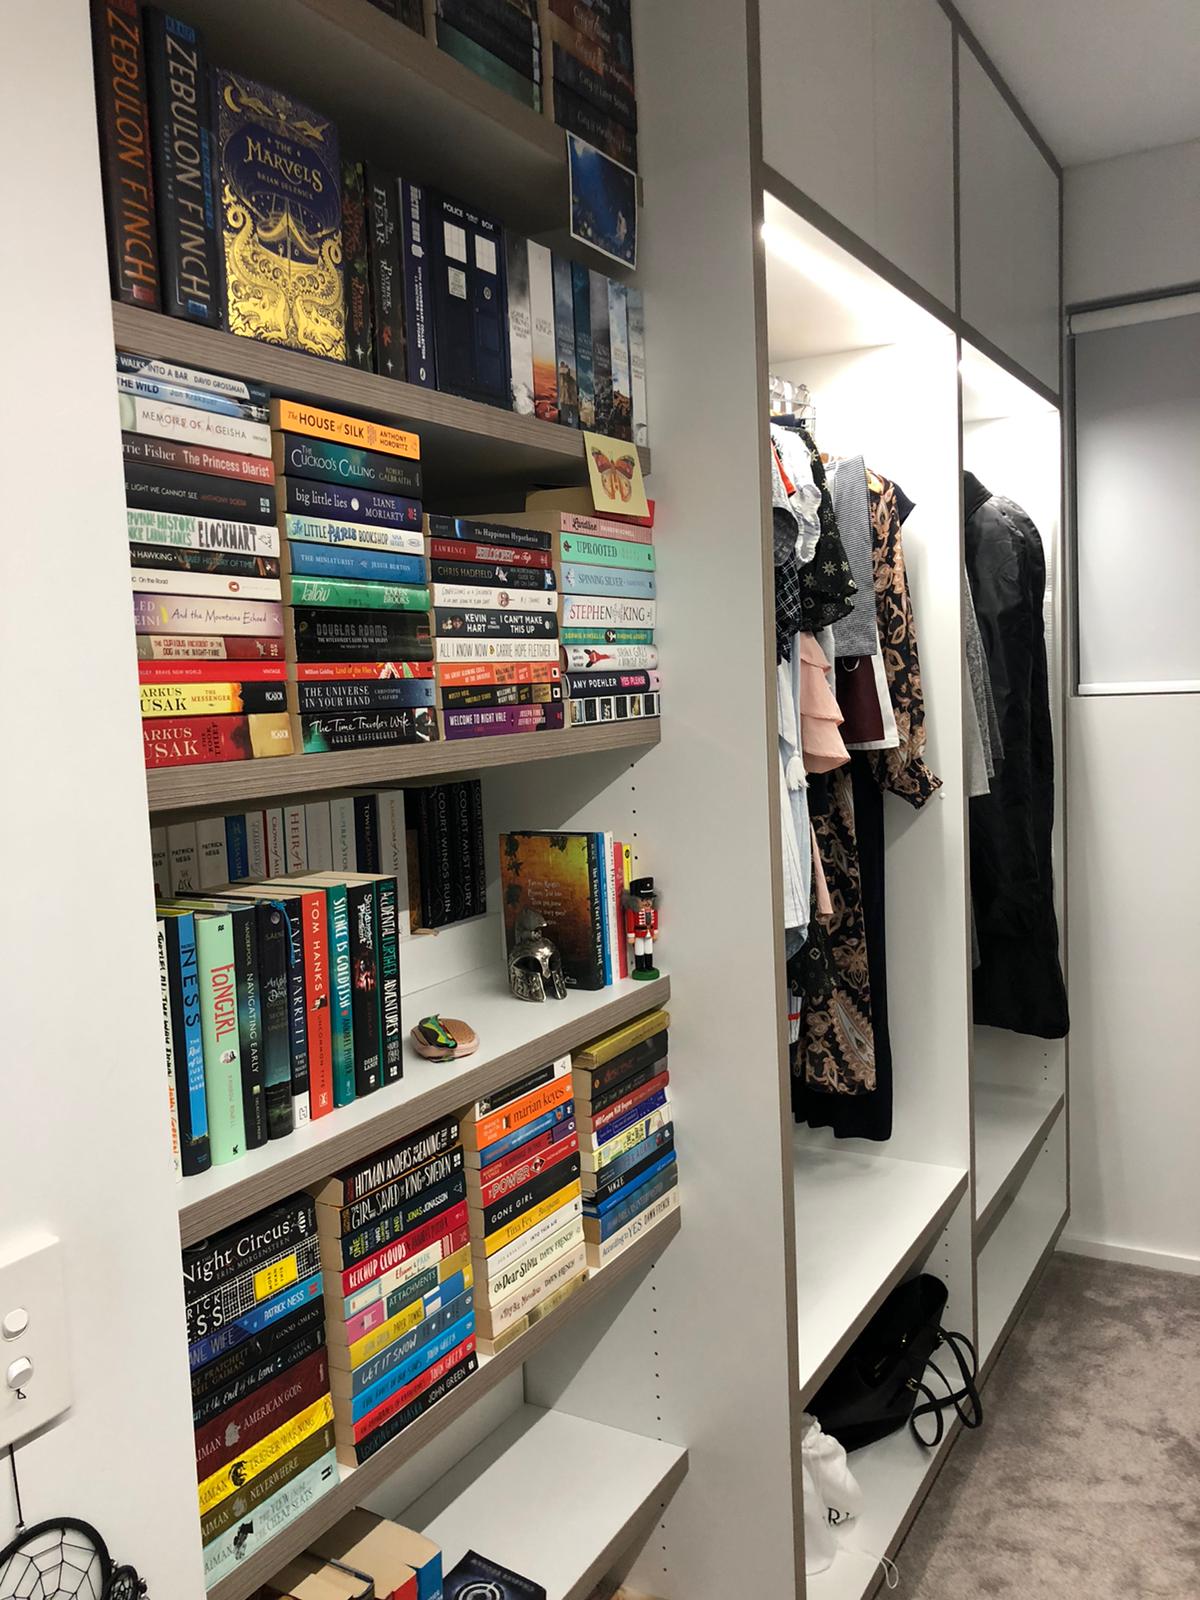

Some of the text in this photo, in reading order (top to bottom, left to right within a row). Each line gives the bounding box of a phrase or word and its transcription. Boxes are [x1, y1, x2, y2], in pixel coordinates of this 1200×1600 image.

[167, 35, 201, 190] ZEBULON
[108, 9, 156, 284] ZEBULON FINCH
[443, 203, 464, 218] POLICE
[482, 220, 495, 231] BOX
[179, 199, 210, 299] FINCH
[136, 380, 160, 394] WILD
[148, 364, 166, 376] INTO
[167, 370, 174, 378] A
[175, 371, 189, 380] BAR
[194, 376, 212, 386] DAVID
[213, 380, 245, 394] GROSSMAN
[143, 412, 187, 428] MEMOIRS
[206, 422, 214, 432] A
[215, 426, 247, 440] GEISHA
[299, 414, 336, 433] HOUSE
[345, 424, 365, 439] SILK
[380, 430, 407, 443] ANTHONY
[302, 445, 313, 456] THE
[380, 439, 409, 451] HOROWITZ
[145, 445, 271, 478] Fisher The Princess Diarist
[292, 450, 376, 480] CUCKOO'S CALLING
[131, 484, 198, 501] LIGHT WE CANNOT SEE
[296, 488, 348, 510] big little lies
[373, 497, 397, 510] LIANE
[365, 508, 405, 522] MORIARTY
[304, 524, 327, 540] LITTLE
[328, 525, 358, 543] PARIS
[359, 531, 389, 546] BOOKSHOP
[138, 552, 173, 563] HAWKING
[301, 554, 314, 562] THE
[576, 542, 618, 558] UPROOTED
[438, 566, 459, 577] CHRIS
[465, 614, 488, 623] KEVIN
[500, 615, 543, 625] I CAN'T MAKE
[570, 605, 645, 622] STEPHEN KING
[358, 624, 388, 637] ADAMS
[467, 624, 486, 633] HART
[511, 625, 535, 634] THIS UP
[305, 686, 370, 697] THE UNIVERSE
[573, 679, 617, 689] AMY POEHLER
[140, 688, 187, 713] ARKUS USAK
[305, 697, 371, 709] IN YOUR HAND
[450, 714, 473, 727] WELCOME
[473, 714, 481, 724] TO
[143, 728, 193, 742] ARKUS
[444, 885, 452, 914] RUIN
[312, 901, 324, 992] TOM HANKS
[333, 897, 351, 1010] SILENCE IS GOLDFISH
[182, 949, 200, 1028] NESS
[248, 974, 259, 1073] NAVIGATING EARLY
[513, 1089, 565, 1123] marian keyes
[355, 1164, 385, 1198] HITMAN
[386, 1147, 412, 1178] ANDERS
[352, 1199, 373, 1230] GIRL
[376, 1184, 400, 1217] SAVED
[405, 1175, 423, 1201] KING
[425, 1154, 452, 1188] SWEDEN
[406, 1194, 449, 1224] JONAS JONASSON
[492, 1193, 534, 1224] GONE GIRL
[237, 1221, 290, 1257] Circus
[628, 1219, 643, 1240] YES
[350, 1243, 407, 1290] KETCHUP CLOUDS
[502, 1269, 520, 1289] Dear
[388, 1272, 437, 1308] ATTACHMENTS
[211, 1291, 305, 1351] WIFE PATRICK NESS
[362, 1334, 418, 1386] LET IT SNOW
[223, 1382, 240, 1406] End
[428, 1367, 467, 1404] JOHN GREEN
[244, 1382, 303, 1430] AMERICAN GODS
[250, 1456, 300, 1501] NEVERWHERE
